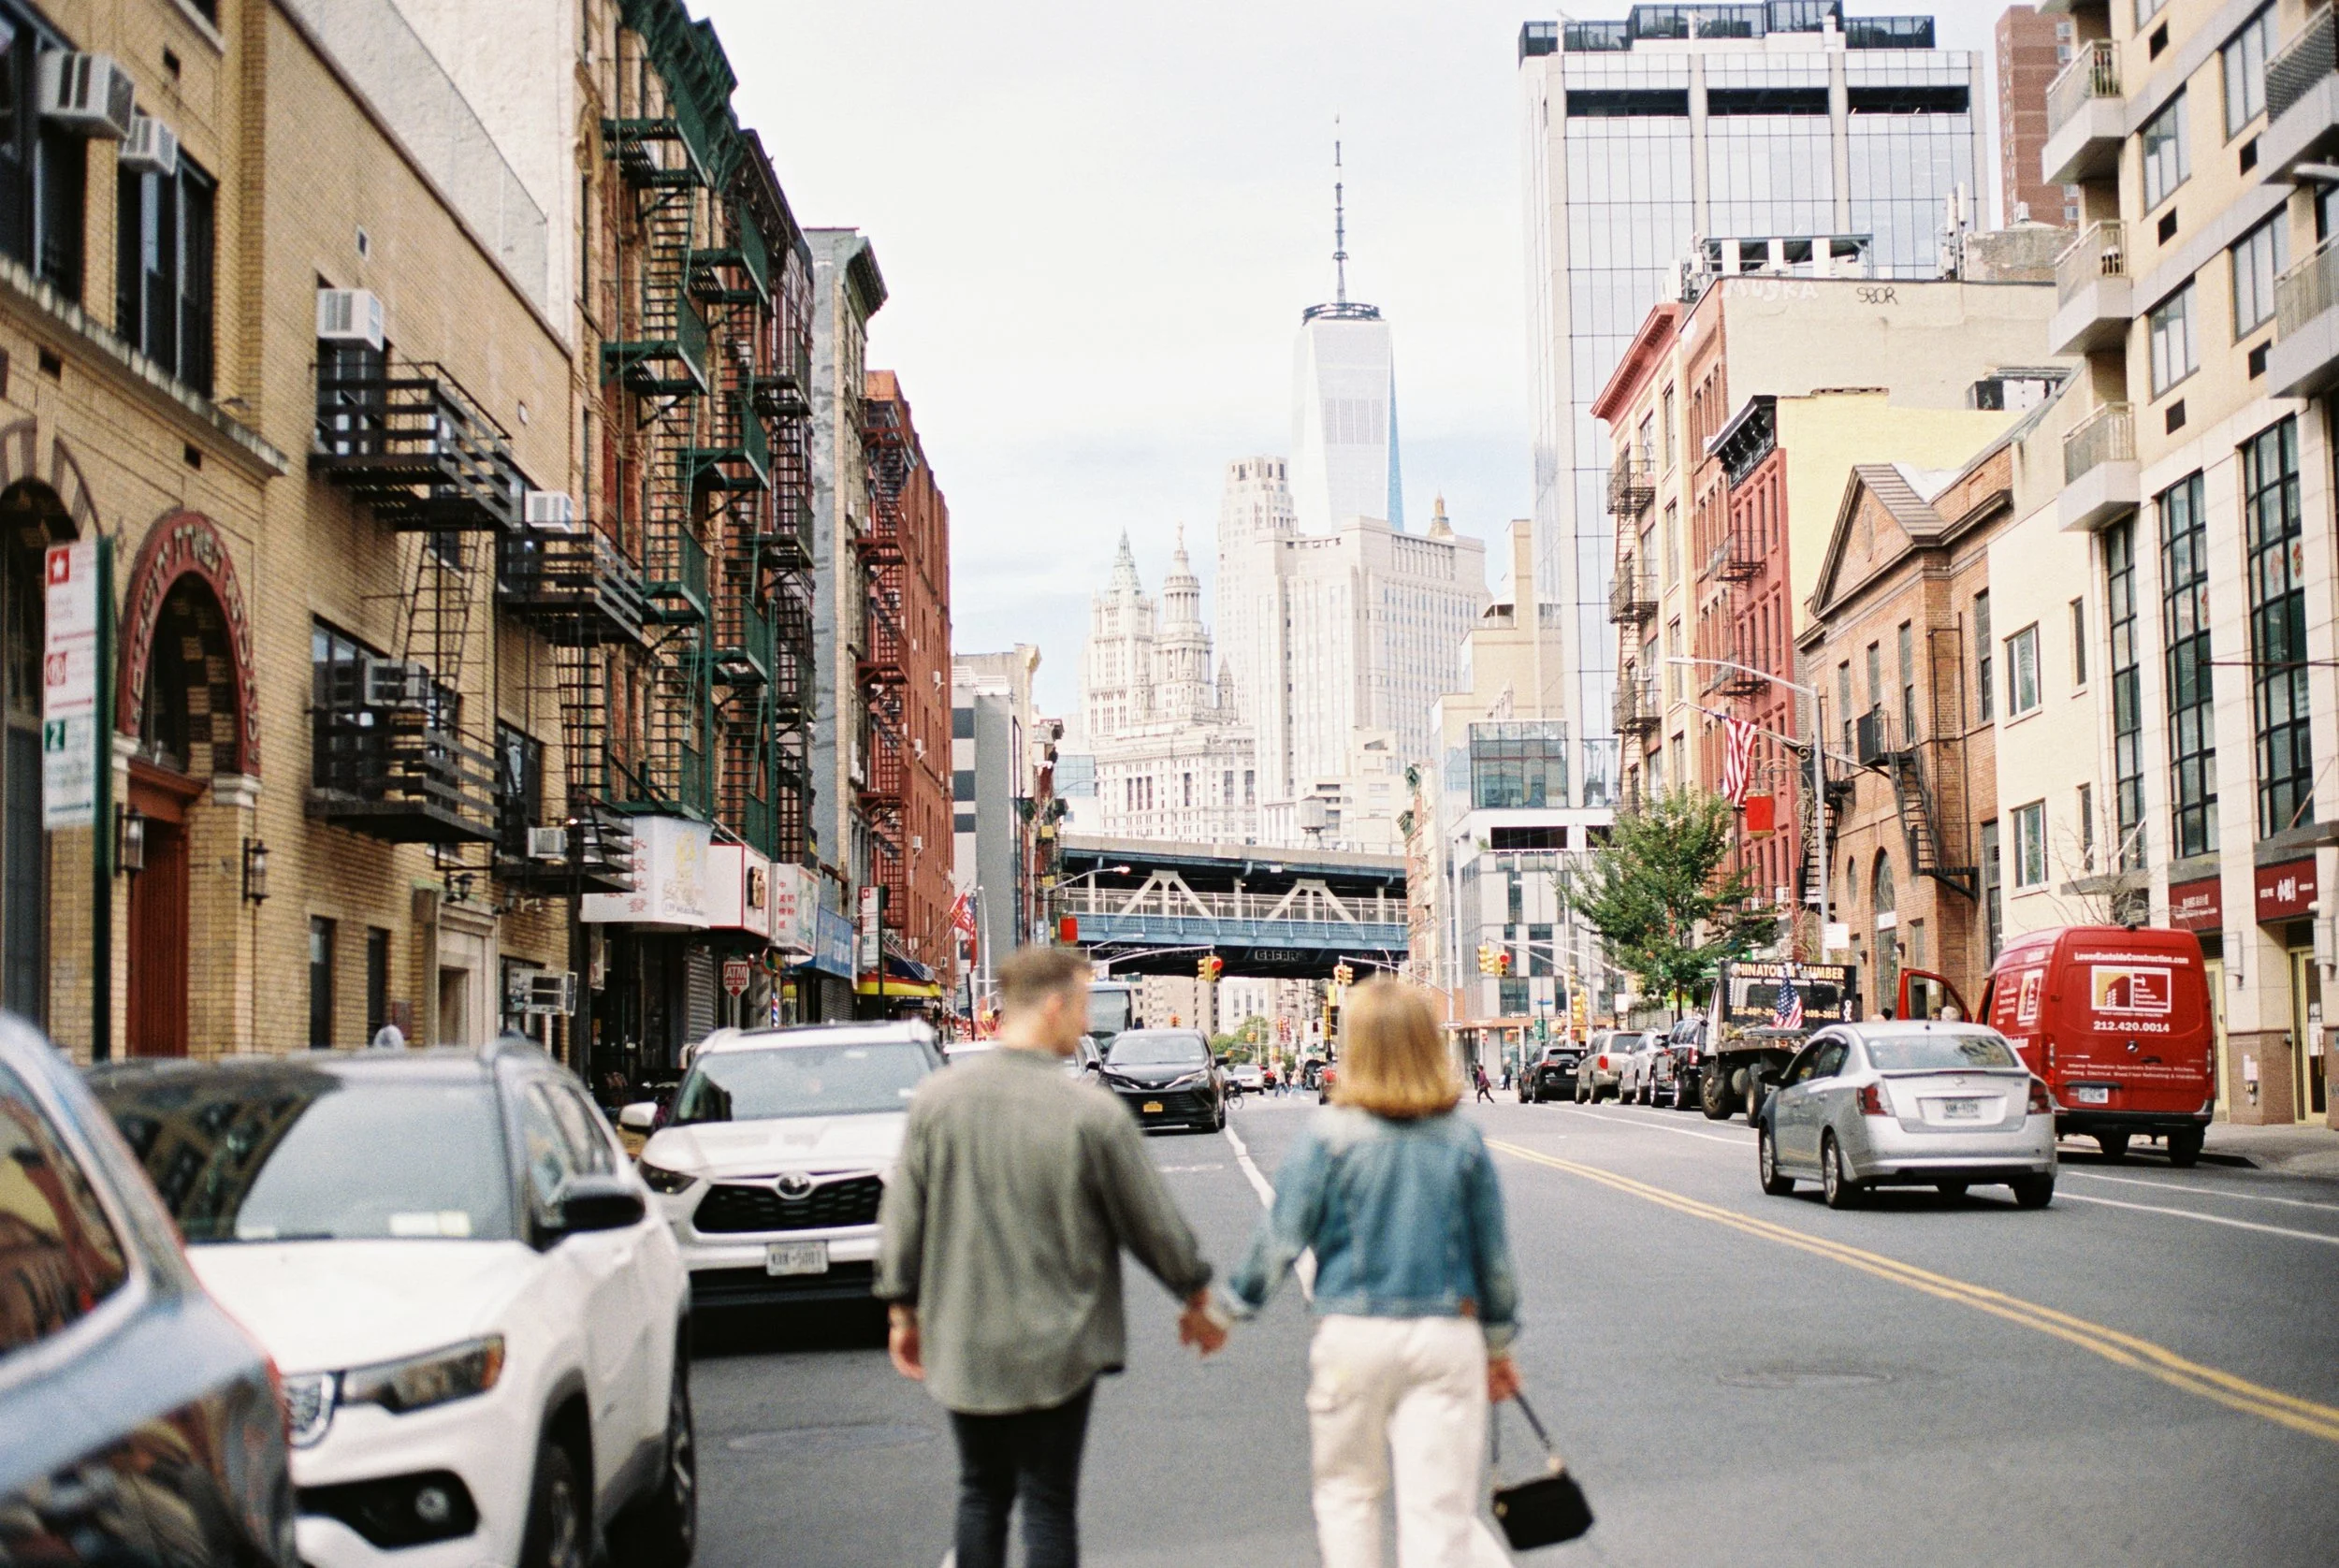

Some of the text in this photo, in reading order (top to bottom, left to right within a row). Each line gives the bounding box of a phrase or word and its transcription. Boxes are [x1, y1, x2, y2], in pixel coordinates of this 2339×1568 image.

[2074, 951, 2189, 965] LowerEastsideConstruction.com
[726, 965, 748, 979] ATM
[1732, 964, 1795, 979] HINATON
[2093, 1021, 2171, 1033] 212.420.0014
